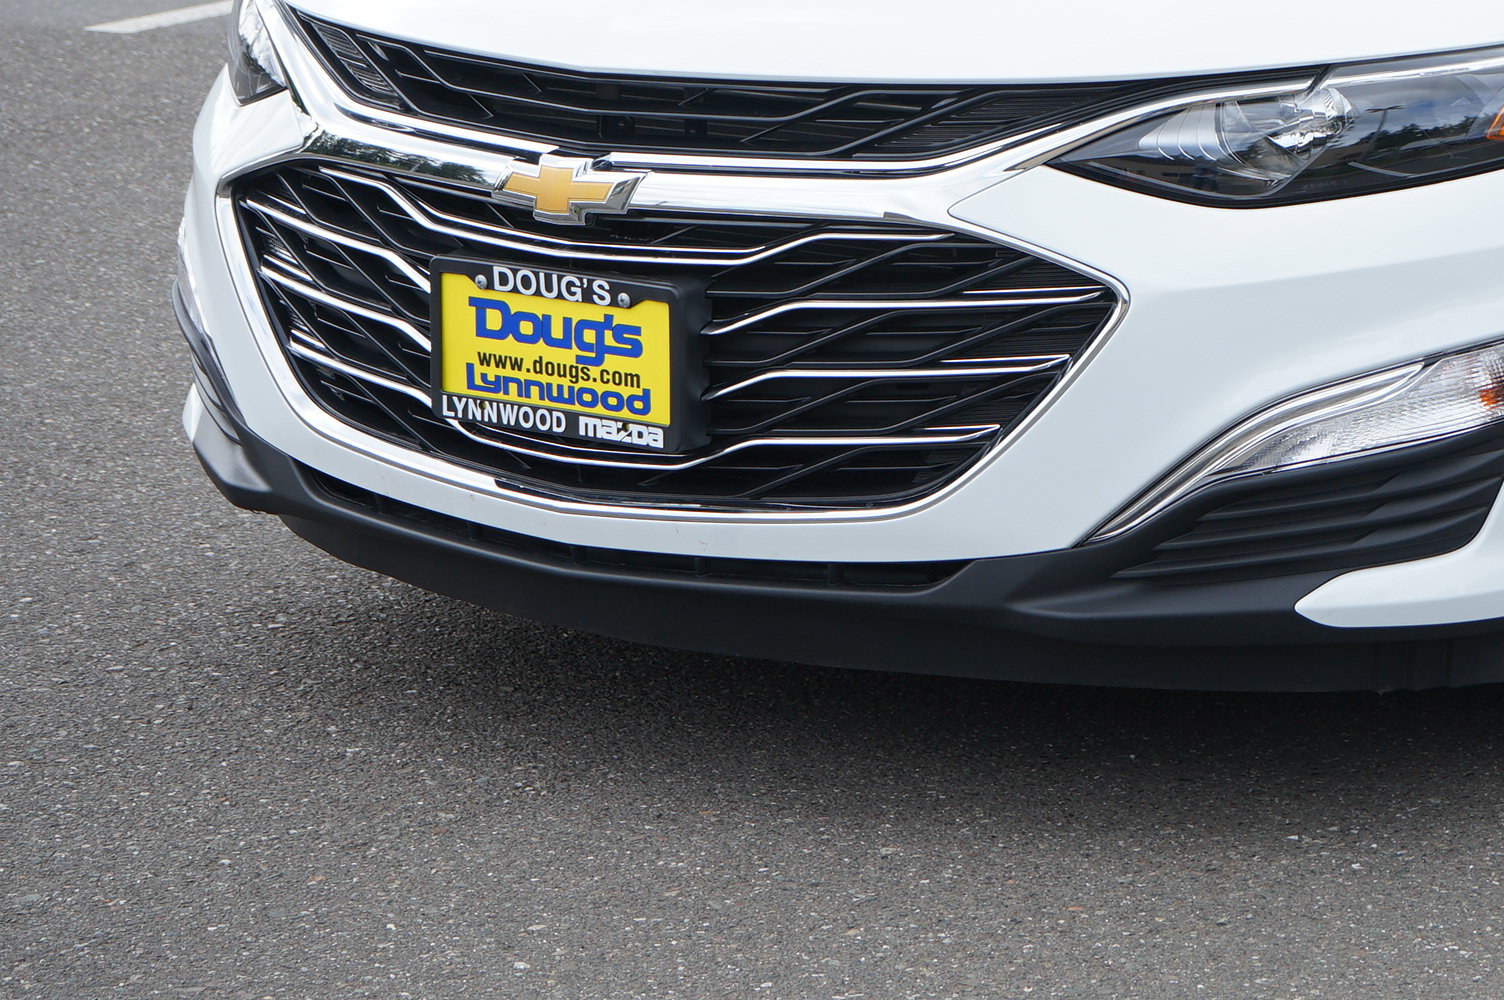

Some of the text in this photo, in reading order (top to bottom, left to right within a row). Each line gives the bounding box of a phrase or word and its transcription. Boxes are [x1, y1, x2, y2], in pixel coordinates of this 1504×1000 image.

[493, 265, 612, 307] DOUG'S
[468, 296, 644, 367] Doug's
[466, 362, 652, 417] Lynnwood
[477, 350, 642, 389] www.dougs.com
[441, 394, 567, 434] LYNNWOOD
